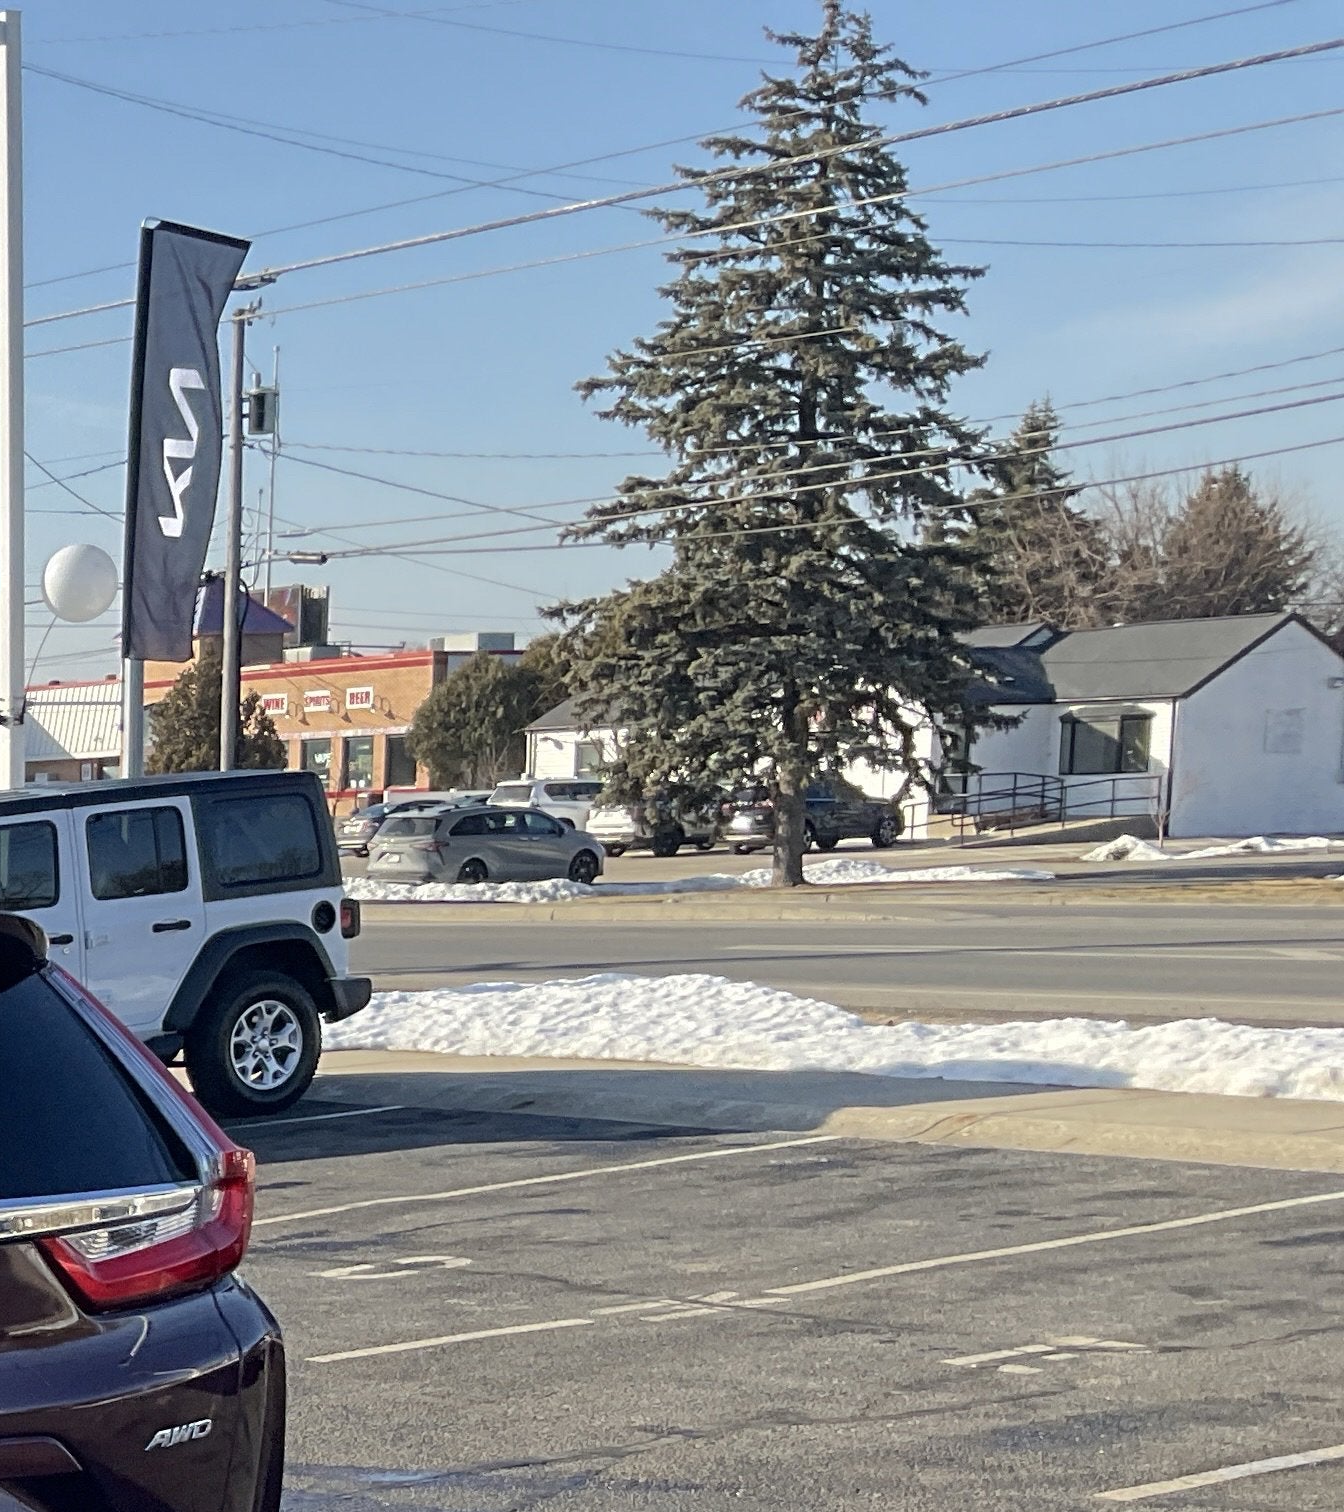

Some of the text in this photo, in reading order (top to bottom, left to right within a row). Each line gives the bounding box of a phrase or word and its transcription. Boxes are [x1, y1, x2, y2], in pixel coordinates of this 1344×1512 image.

[263, 697, 285, 711] WINE
[349, 691, 371, 705] BEER
[144, 1418, 212, 1451] AWD
